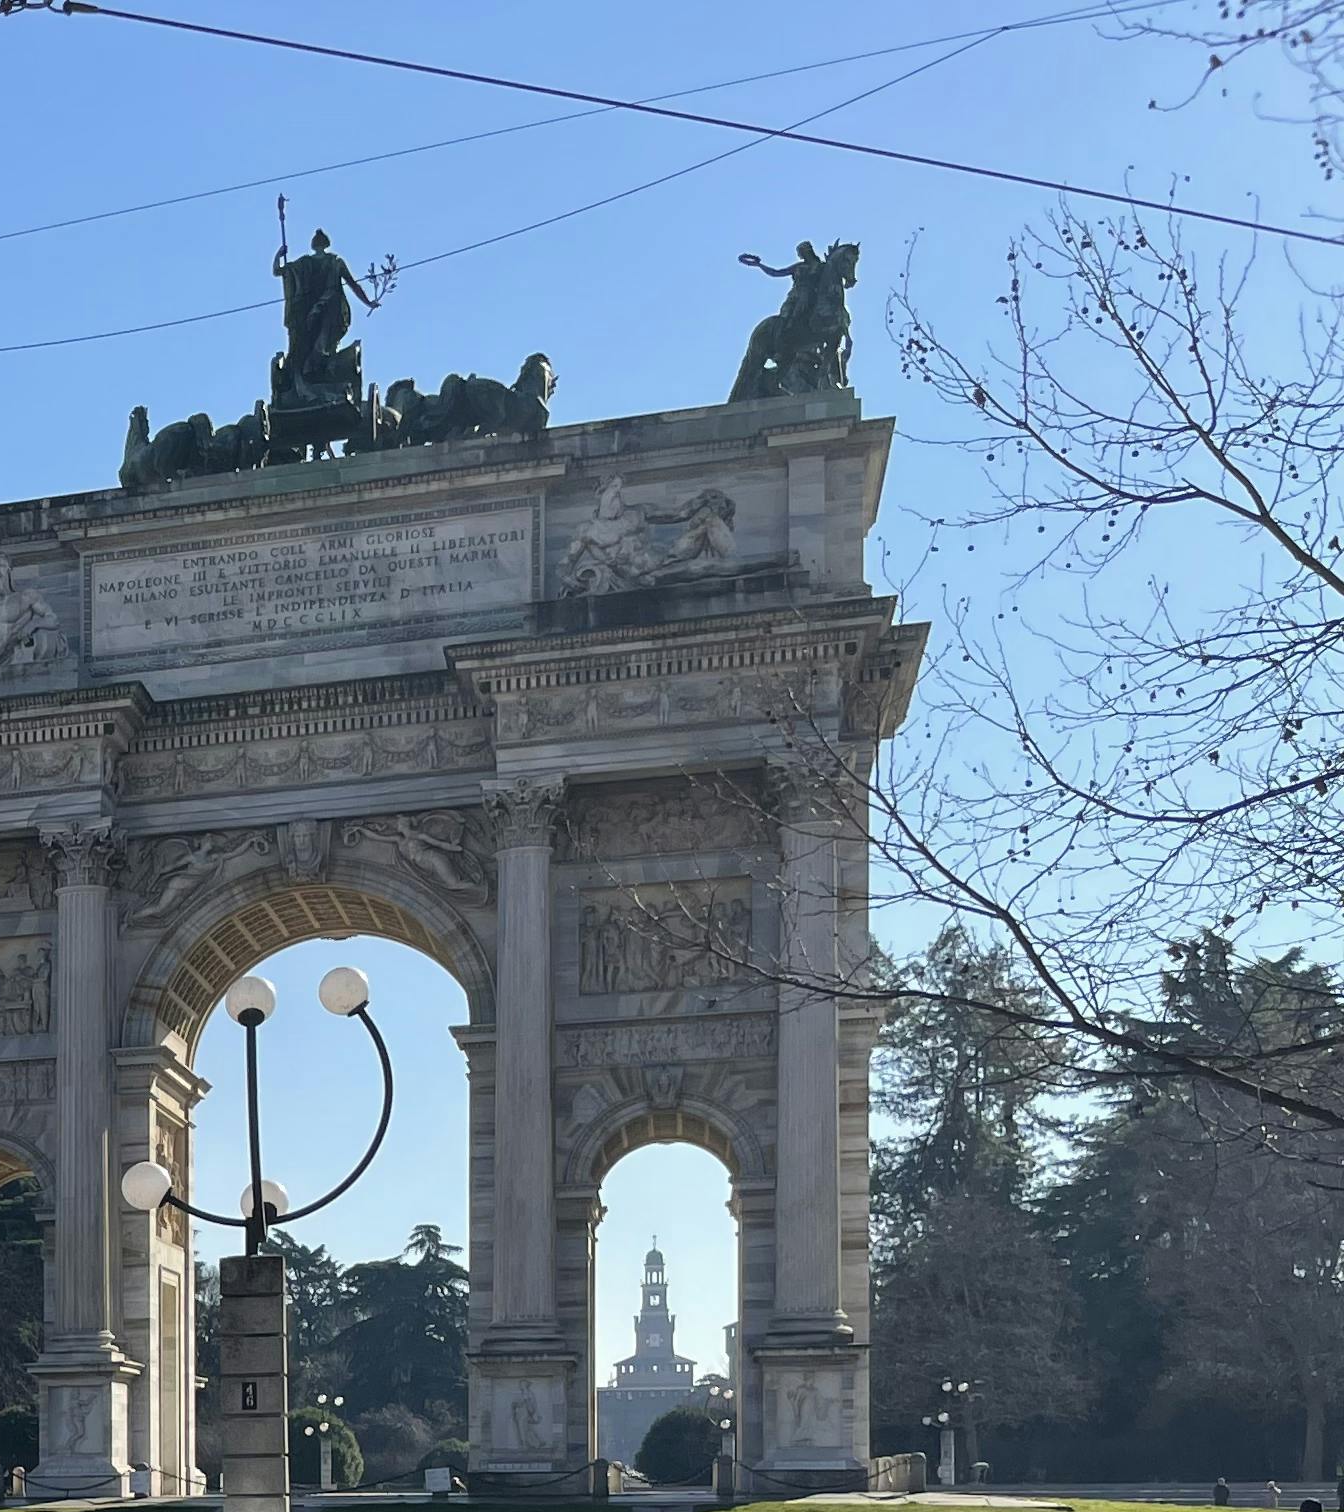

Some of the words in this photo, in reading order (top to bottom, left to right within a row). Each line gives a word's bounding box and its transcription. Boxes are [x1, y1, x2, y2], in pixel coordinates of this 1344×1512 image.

[98, 574, 181, 594] NAPOLEONE
[192, 571, 207, 582] III
[217, 568, 226, 579] E
[238, 558, 307, 575] VITTORIO
[318, 546, 399, 567] EMANUELE
[410, 544, 420, 554] II
[432, 529, 526, 552] LIBERATORI
[182, 550, 259, 569] ENTRANDO
[318, 535, 354, 552] ARMI
[366, 526, 437, 545] GLORIOSE
[122, 588, 178, 605] MILANO
[189, 577, 266, 597] ESULTANTE
[274, 567, 349, 586] CANCELLO
[359, 564, 377, 576] DA
[388, 556, 439, 572] QUESTI
[449, 547, 499, 565] MARMI
[223, 595, 238, 607] LE
[249, 584, 323, 604] IMPRONTE
[335, 575, 392, 593] SERVILI
[144, 619, 152, 630] E
[165, 614, 178, 627] VI
[190, 607, 245, 625] SCRISSE
[274, 590, 387, 614] INDIPENDENZA
[422, 579, 474, 597] ITALIA
